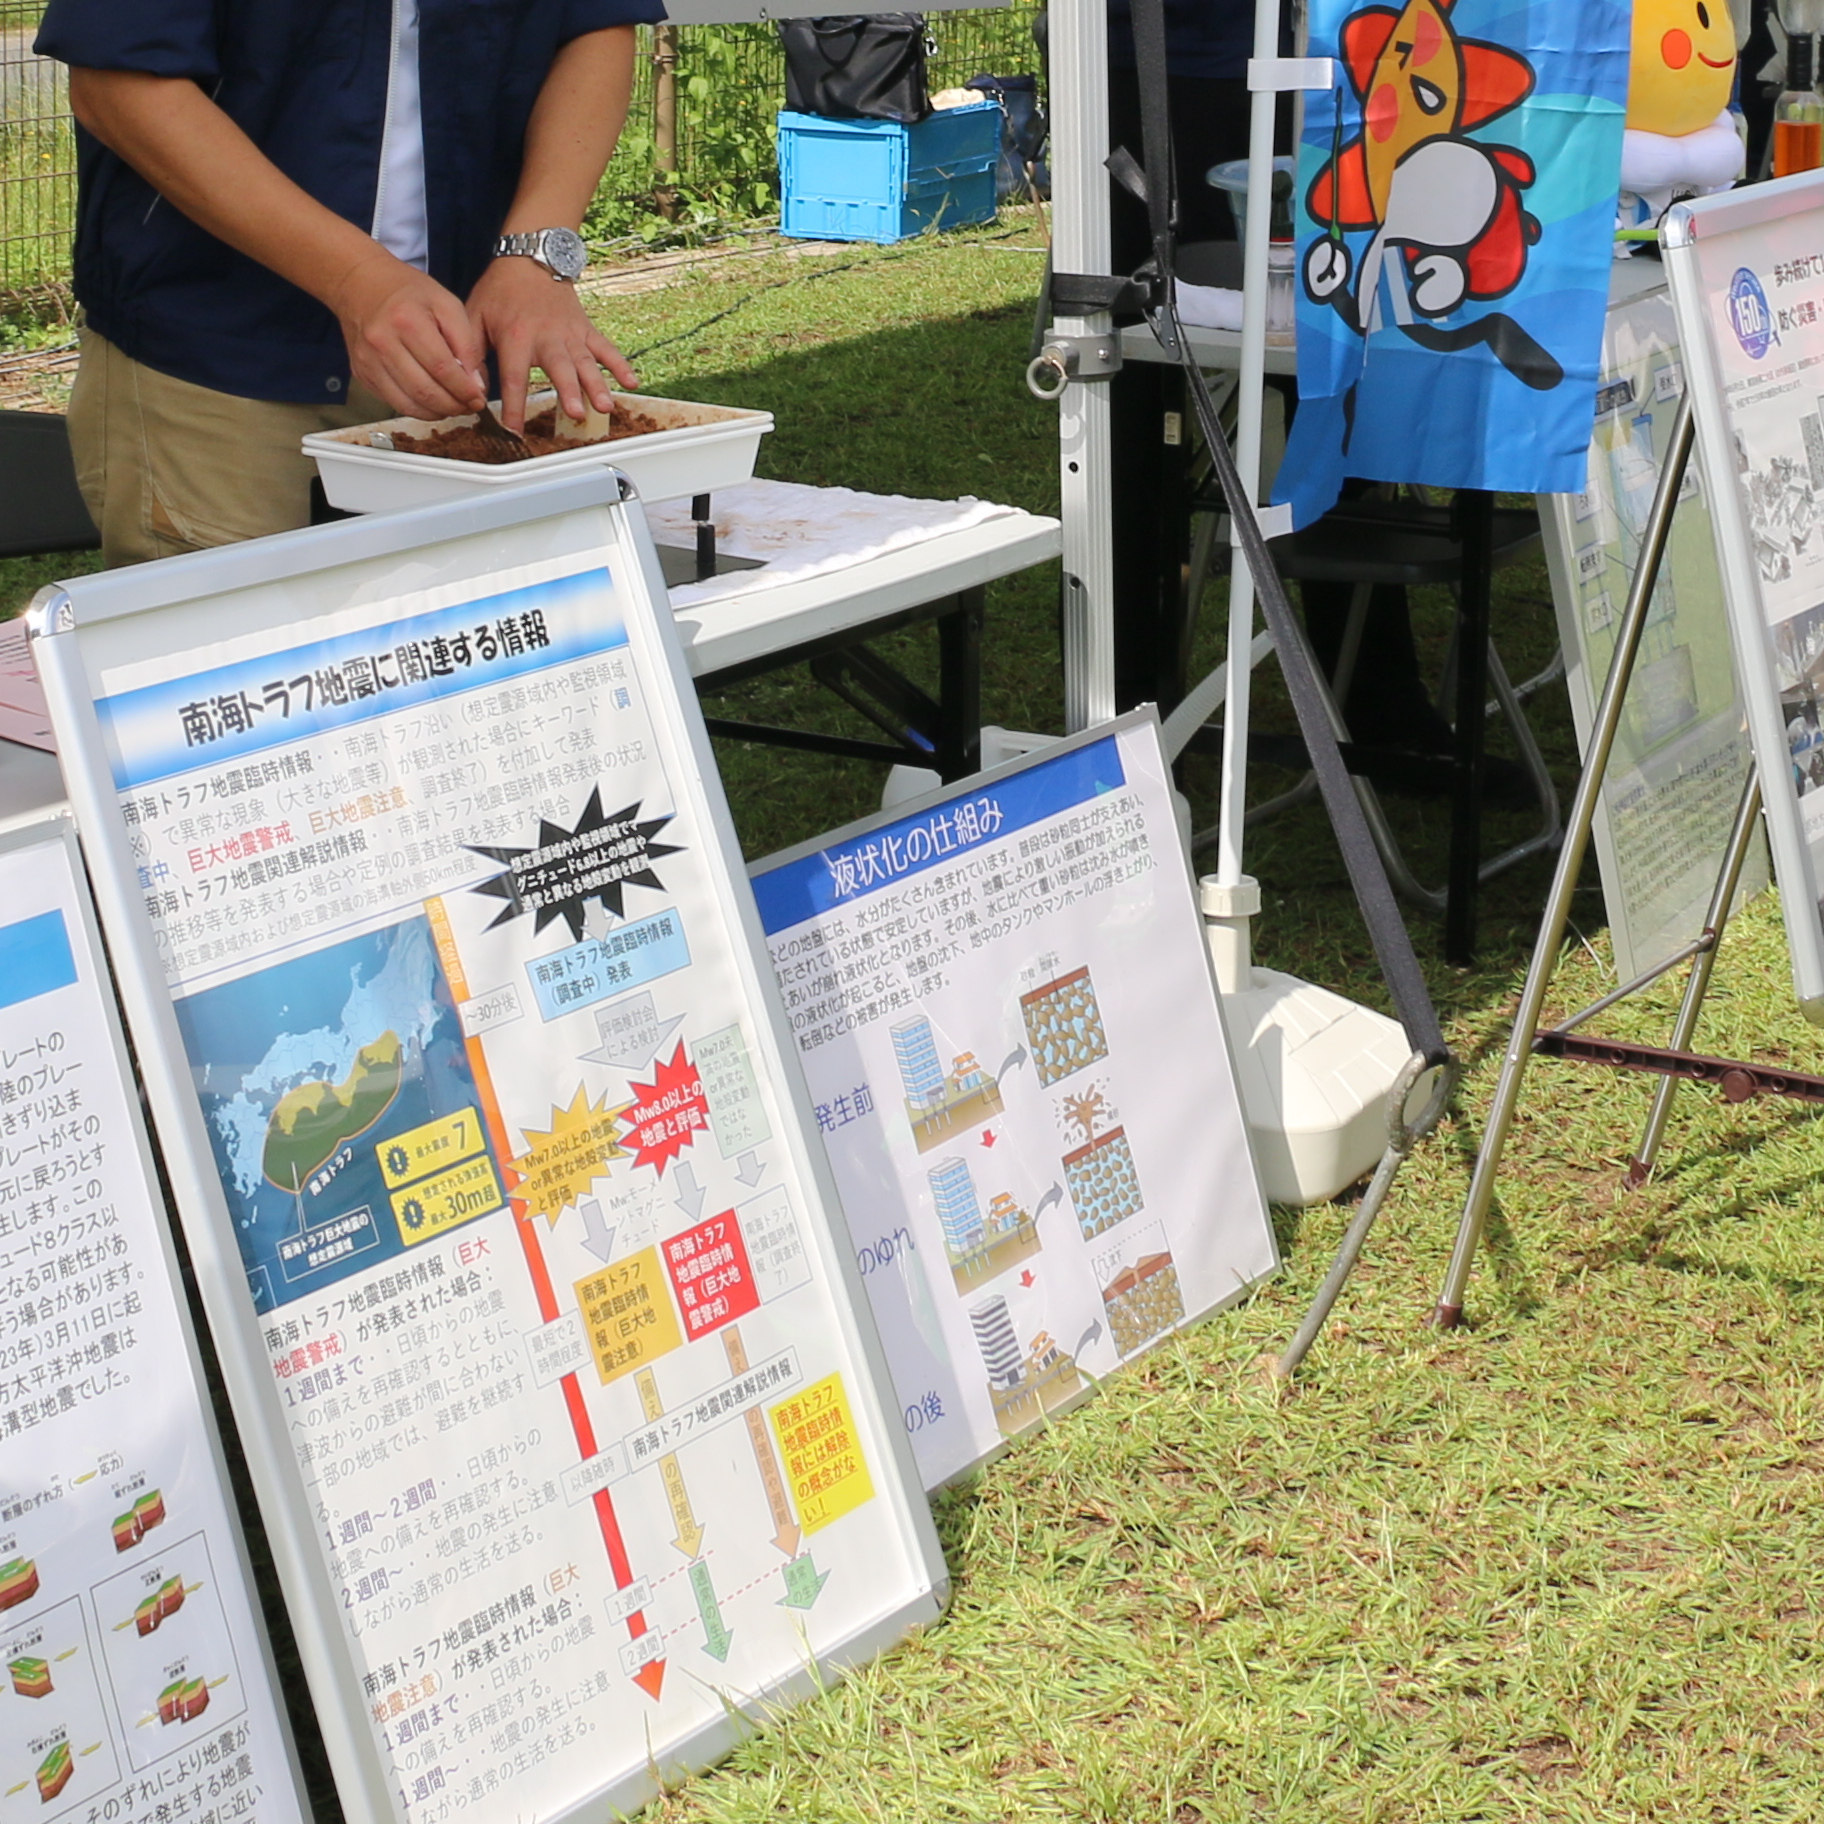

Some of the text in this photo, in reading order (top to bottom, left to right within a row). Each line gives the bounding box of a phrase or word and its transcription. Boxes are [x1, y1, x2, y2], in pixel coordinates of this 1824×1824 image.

[1735, 294, 1763, 337] 150
[178, 607, 551, 749] 南海トラフ地震に関連する情報
[829, 797, 1005, 899] 液状化の仕組み
[535, 916, 675, 985] 南海トラフ地震臨時情報
[799, 972, 951, 1052] 転倒などの被害が発生します。
[632, 1079, 704, 1126] Mw8.0以上の
[524, 1117, 614, 1170] Mw7.0以上の地震
[640, 1106, 702, 1149] 地震と評価
[308, 1146, 355, 1197] 南海トラフ
[530, 1138, 620, 1191] or異常な地殻変動
[537, 1185, 573, 1213] と評価
[669, 1221, 726, 1263] 南海トラフ
[676, 1242, 735, 1284] 地震臨時情
[856, 1226, 915, 1277] のゆれ
[264, 1236, 491, 1353] 南海トラフ地震臨時情報（巨大
[581, 1262, 642, 1303] 南海トラフ
[588, 1283, 649, 1325] 地震臨時情
[682, 1264, 741, 1308] 報（巨大地
[595, 1304, 658, 1349] 報（巨大地
[688, 1294, 730, 1330] 震警戒）
[602, 1334, 645, 1374] 震注意）
[296, 1348, 520, 1468] 津波からの避難が間に合わない
[632, 1358, 794, 1458] 南海トラフ地震関連解説情報
[775, 1384, 837, 1430] 南海トラフ
[783, 1407, 845, 1451] 地震臨時情
[904, 1390, 946, 1434] の後
[307, 1373, 524, 1489] 一部の地域では、避難を継続す
[790, 1430, 852, 1477] 報には解除
[798, 1455, 857, 1499] の概念がな
[1, 1484, 64, 1524] 断層のずれ方
[363, 1561, 581, 1698] 南海トラフ地震臨時情報（巨大
[388, 1674, 553, 1777] への備えを再確認する。
[87, 1720, 251, 1824] そのずれにより地震が
